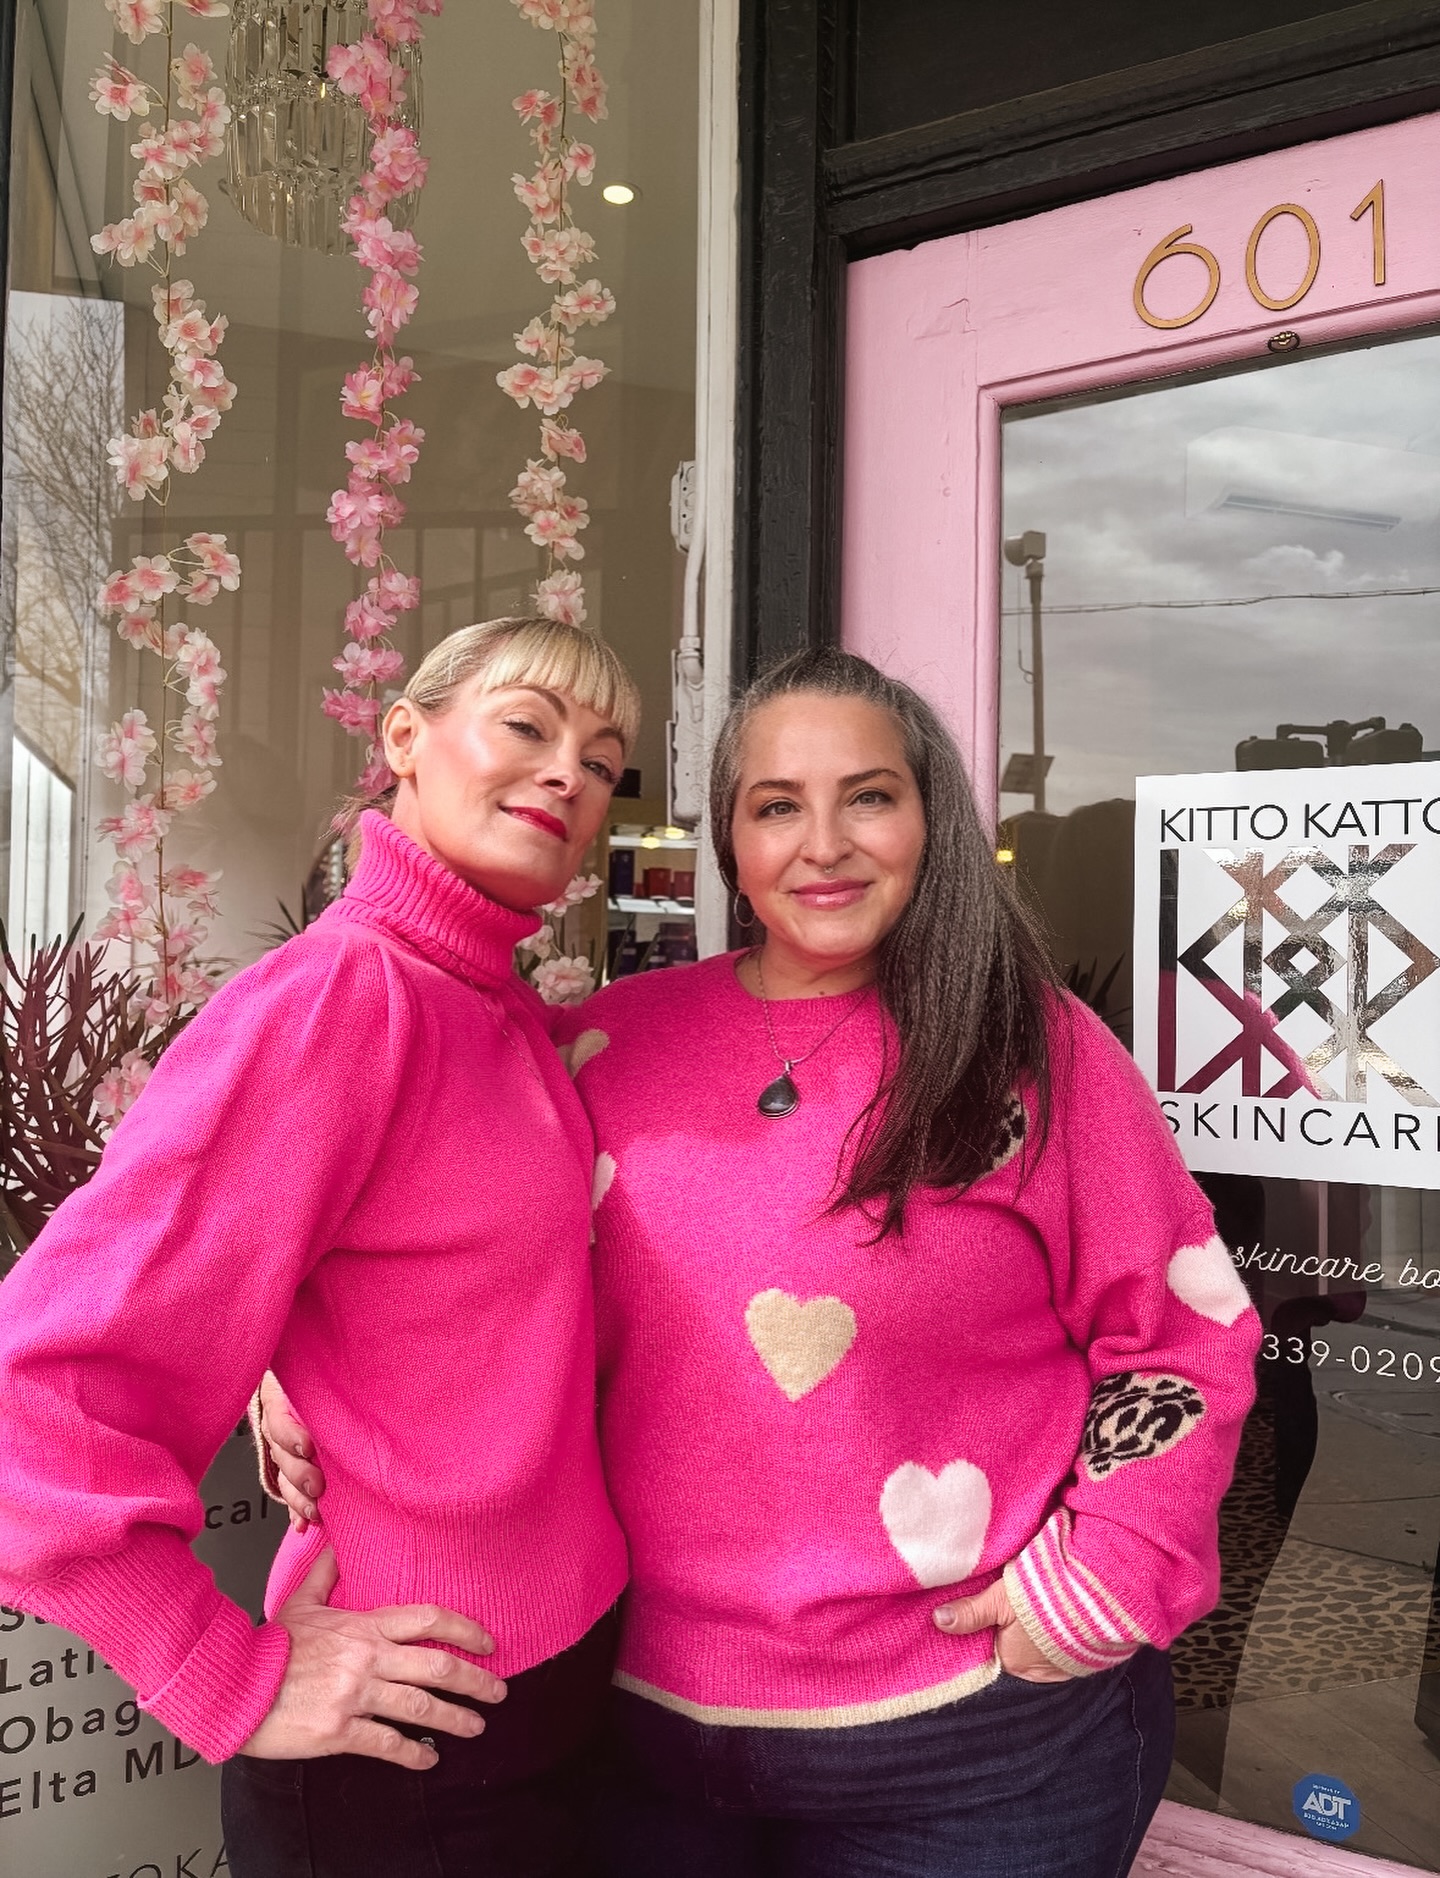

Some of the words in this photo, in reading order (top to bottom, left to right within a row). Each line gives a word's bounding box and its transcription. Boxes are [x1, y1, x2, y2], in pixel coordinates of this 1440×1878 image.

[1133, 178, 1386, 330] 601
[1160, 804, 1289, 843] KITTO
[1160, 1100, 1440, 1152] SKINCAR
[1230, 1242, 1386, 1283] skincare
[0, 1648, 113, 1694] Lati
[0, 1770, 97, 1819] Elta
[1302, 1790, 1352, 1820] ADT
